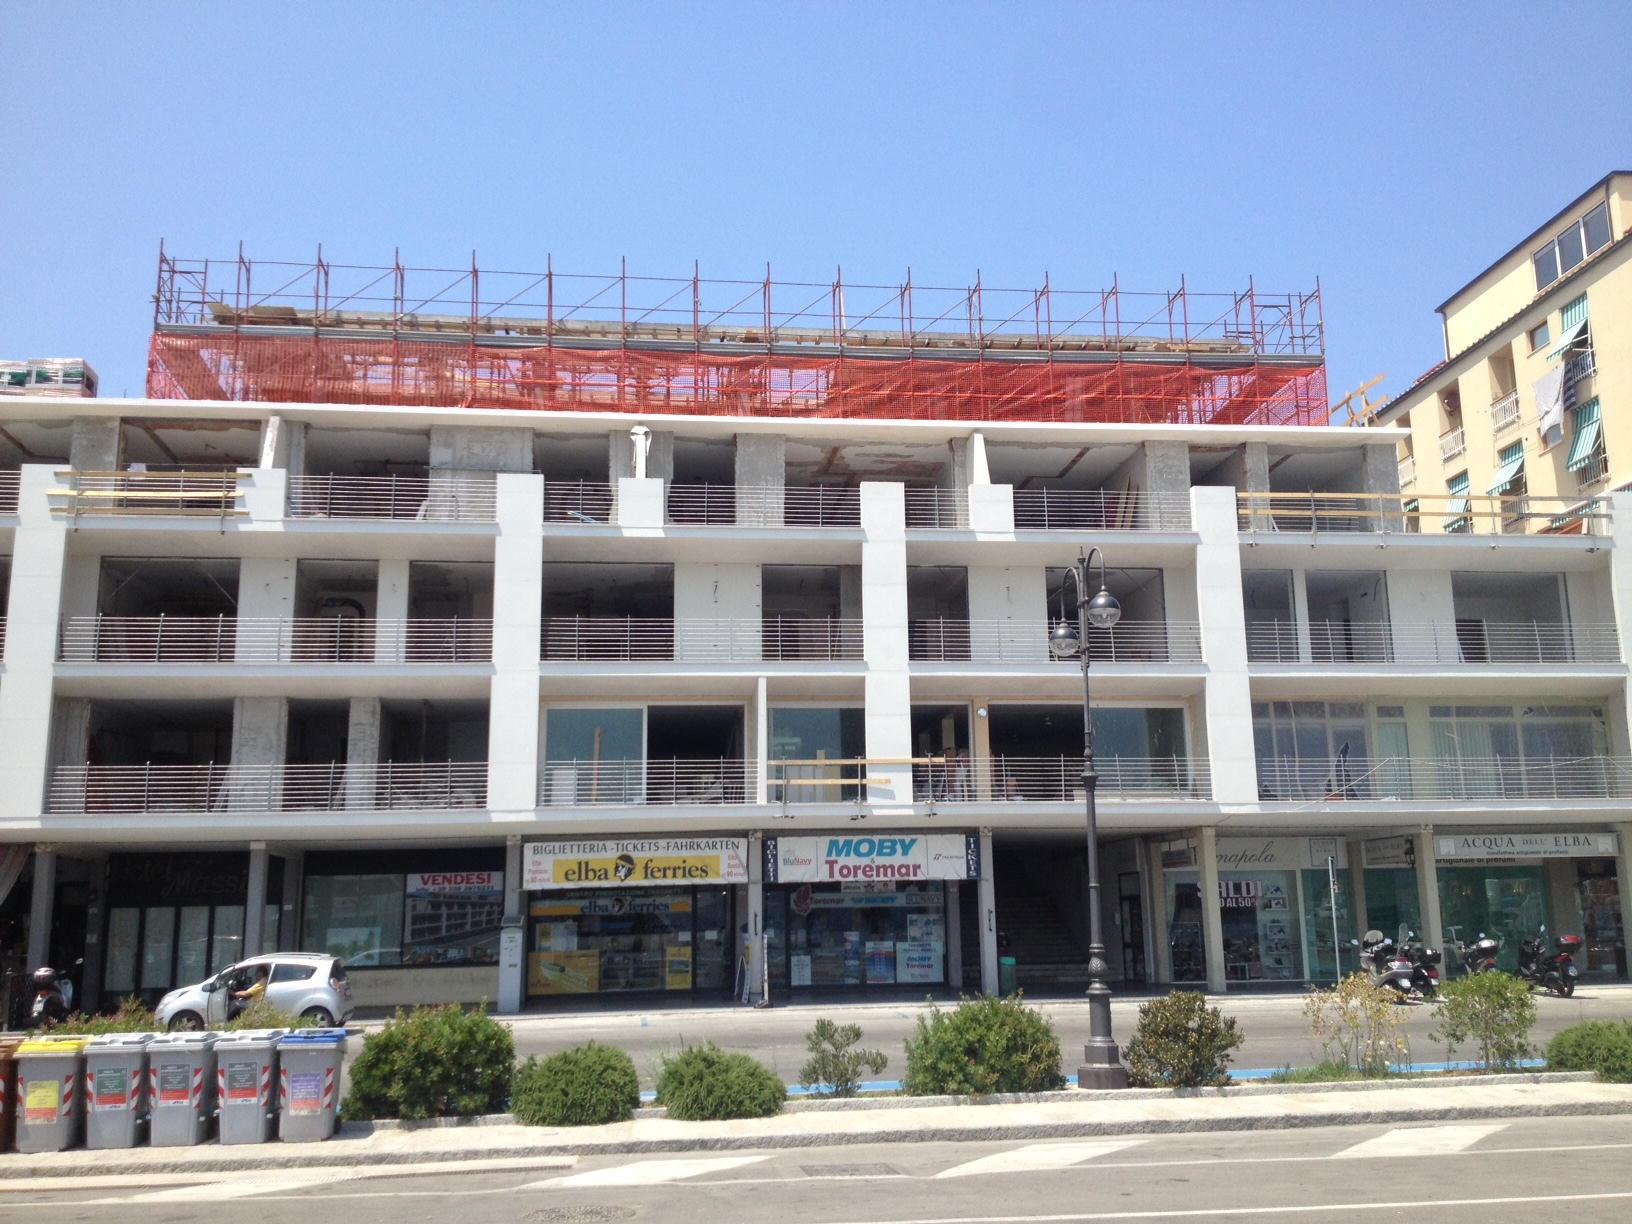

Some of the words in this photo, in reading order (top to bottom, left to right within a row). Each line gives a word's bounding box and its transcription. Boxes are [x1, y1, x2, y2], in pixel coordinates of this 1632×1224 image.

[533, 843, 607, 855] BIGLIETTERIA
[826, 838, 918, 857] MOBY
[1463, 837, 1515, 850] ACQUA
[1554, 836, 1592, 847] ELBA
[968, 837, 977, 877] TICKETS
[564, 860, 609, 881] elba
[644, 859, 709, 879] ferries
[825, 859, 921, 879] Toremar
[421, 873, 492, 886] VENDESI
[582, 898, 609, 913] elba
[629, 898, 670, 913] ferries
[1226, 897, 1237, 907] AL
